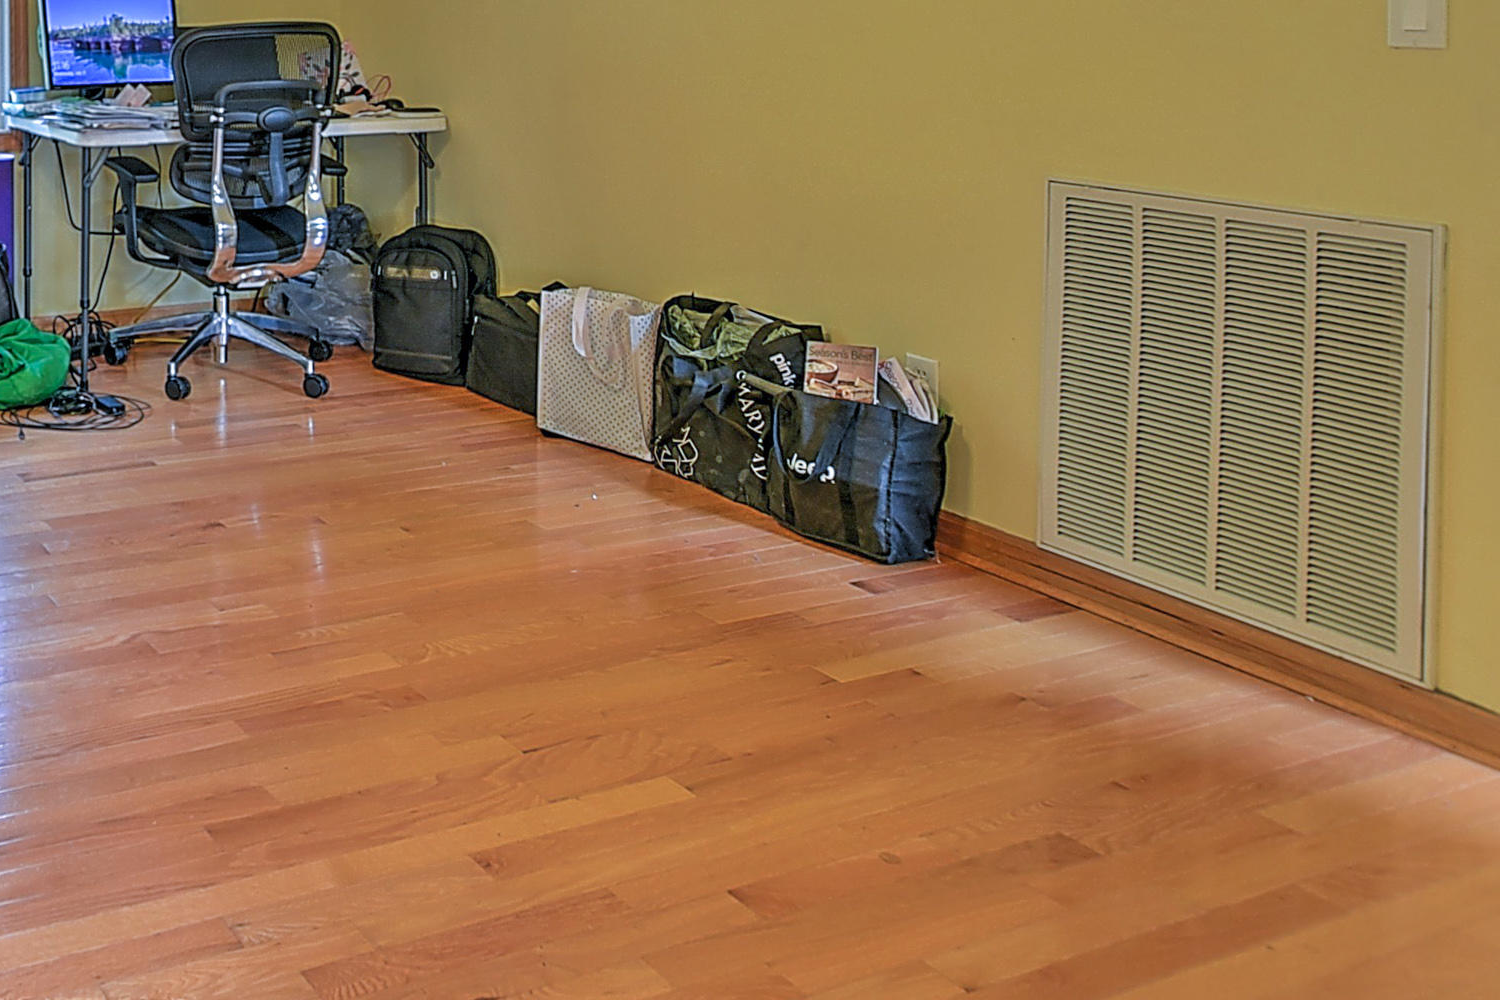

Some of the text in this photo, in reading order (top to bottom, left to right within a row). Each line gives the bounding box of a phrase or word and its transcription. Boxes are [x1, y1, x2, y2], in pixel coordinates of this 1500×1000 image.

[769, 352, 796, 388] pink
[809, 346, 874, 361] Season's Best
[737, 381, 765, 434] MARY
